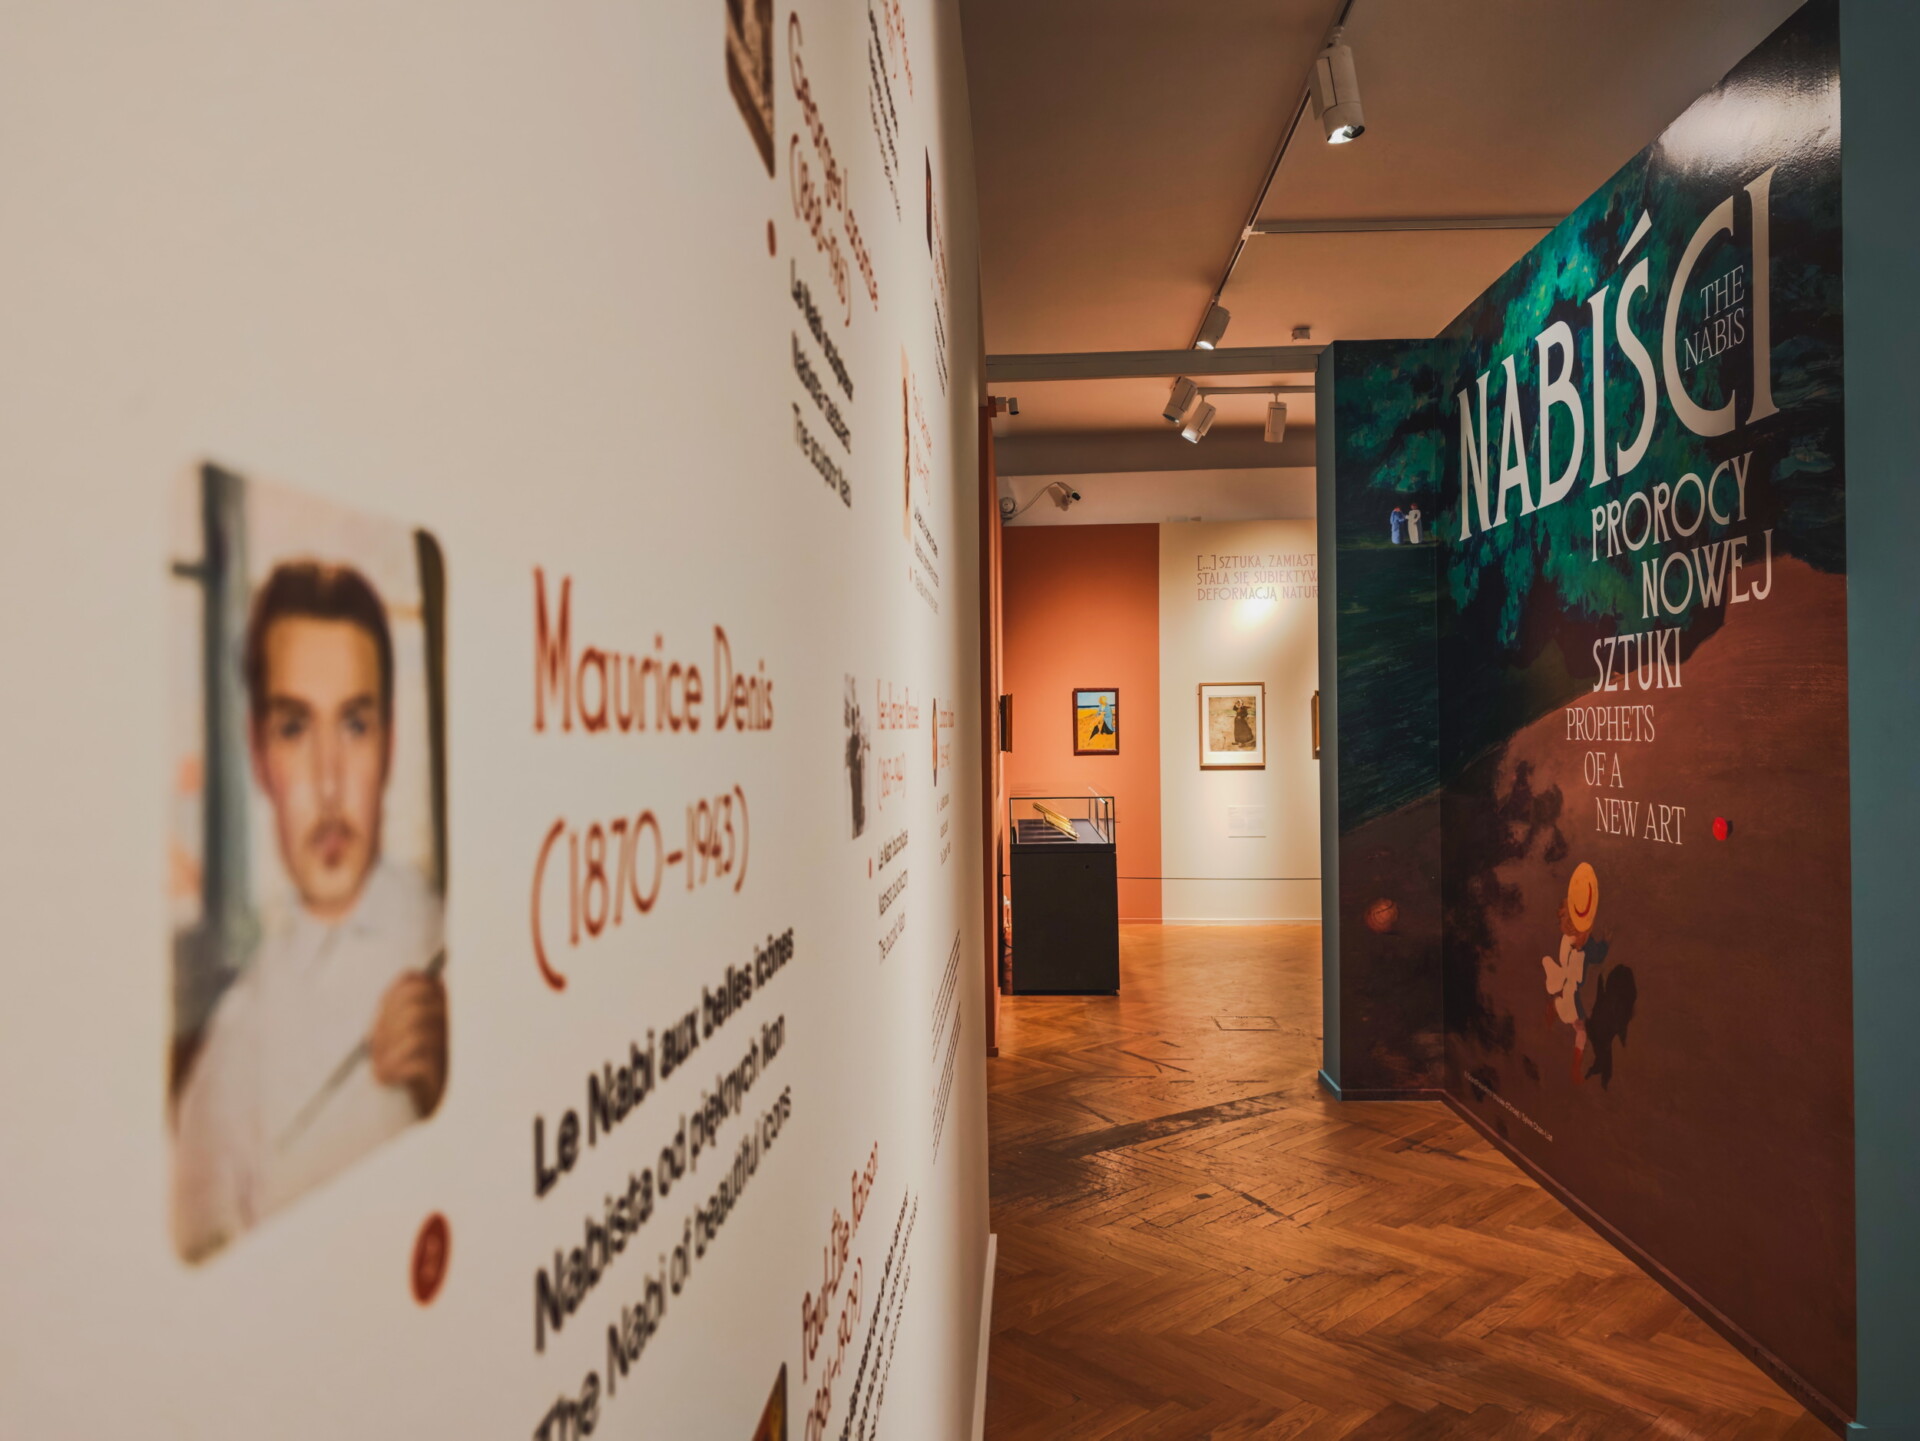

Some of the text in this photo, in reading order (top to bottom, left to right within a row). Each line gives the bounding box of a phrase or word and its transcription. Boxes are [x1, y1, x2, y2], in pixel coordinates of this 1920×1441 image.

[1700, 264, 1745, 321] THE
[1457, 166, 1780, 541] NABIŚCI
[1683, 307, 1745, 371] NABIS
[1591, 451, 1754, 562] PROROCY
[1198, 586, 1278, 601] DEFORMACJĄ
[1269, 553, 1316, 568] ZAMIAST
[1641, 529, 1775, 619] NOWEJ
[532, 565, 774, 733] Maurice Denis
[1592, 627, 1683, 693] SZTUKI
[1566, 705, 1655, 742] PROPHETS
[1584, 751, 1624, 788] OF A
[1595, 797, 1686, 845] NEW ART
[534, 1109, 580, 1199] Le
[588, 1028, 656, 1148] Nabi
[660, 1008, 700, 1080] aux
[702, 964, 752, 1040] belles
[535, 1168, 654, 1353] Nabista
[657, 1113, 686, 1197] od
[607, 1252, 667, 1397] Nabi
[670, 1216, 692, 1295] of
